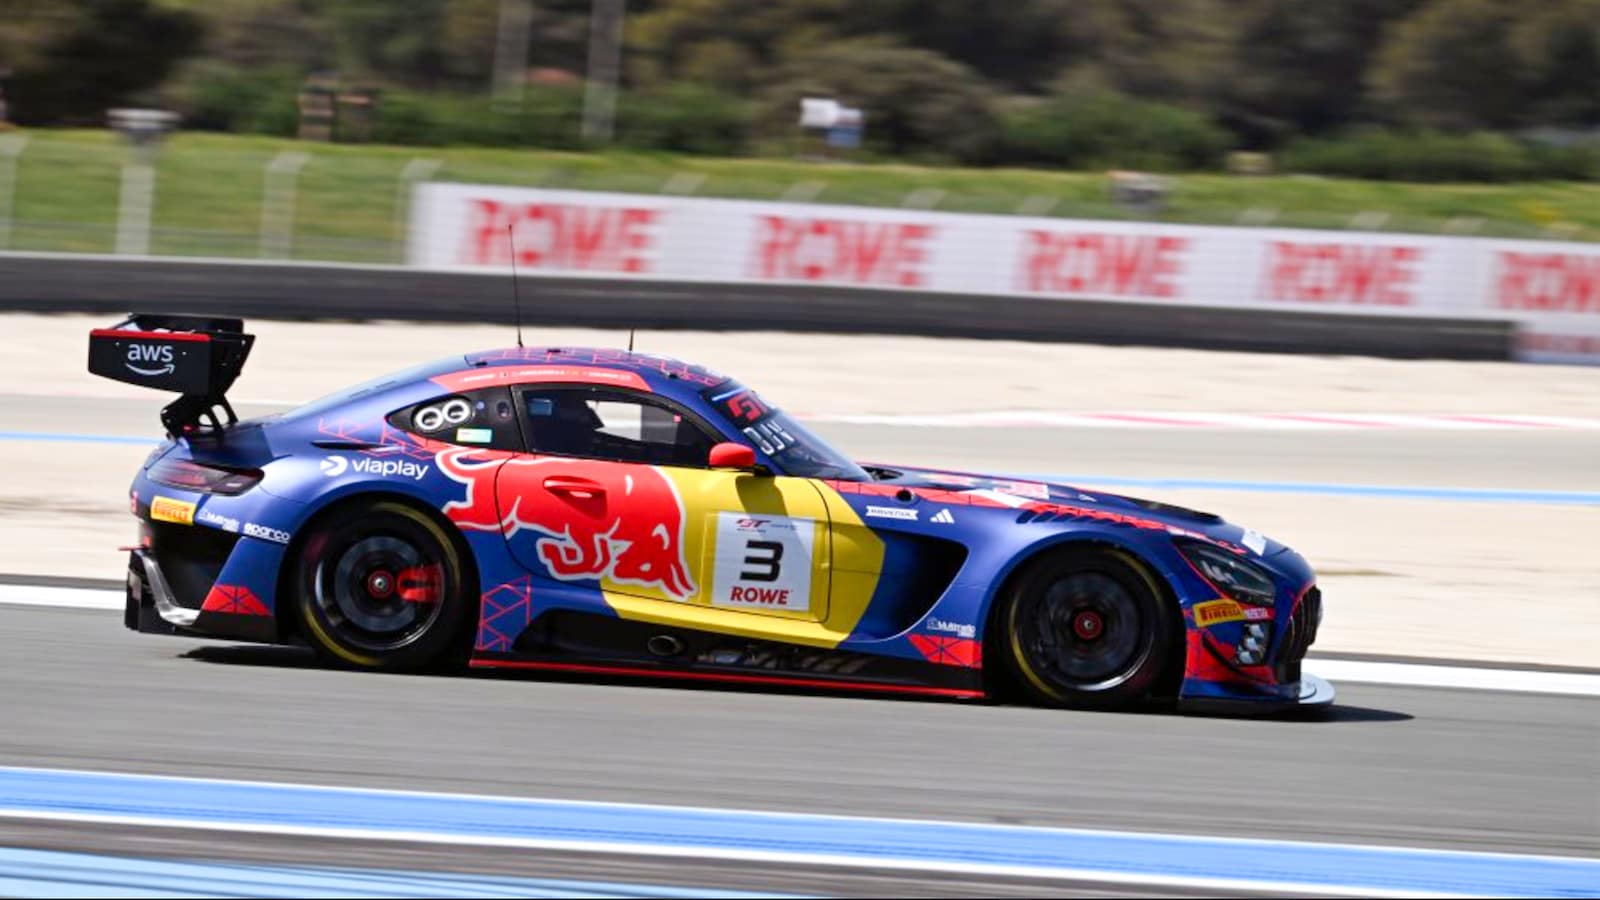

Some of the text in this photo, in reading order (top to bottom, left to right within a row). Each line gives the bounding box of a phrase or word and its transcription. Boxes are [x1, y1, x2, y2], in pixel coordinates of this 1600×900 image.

[460, 199, 664, 272] ROWE
[746, 213, 942, 286] ROWE
[1018, 229, 1191, 297] ROWE
[1260, 241, 1425, 306] ROWE
[127, 343, 174, 363] aws
[351, 458, 429, 480] viaplay
[739, 540, 784, 582] 3
[730, 586, 790, 605] ROWE
